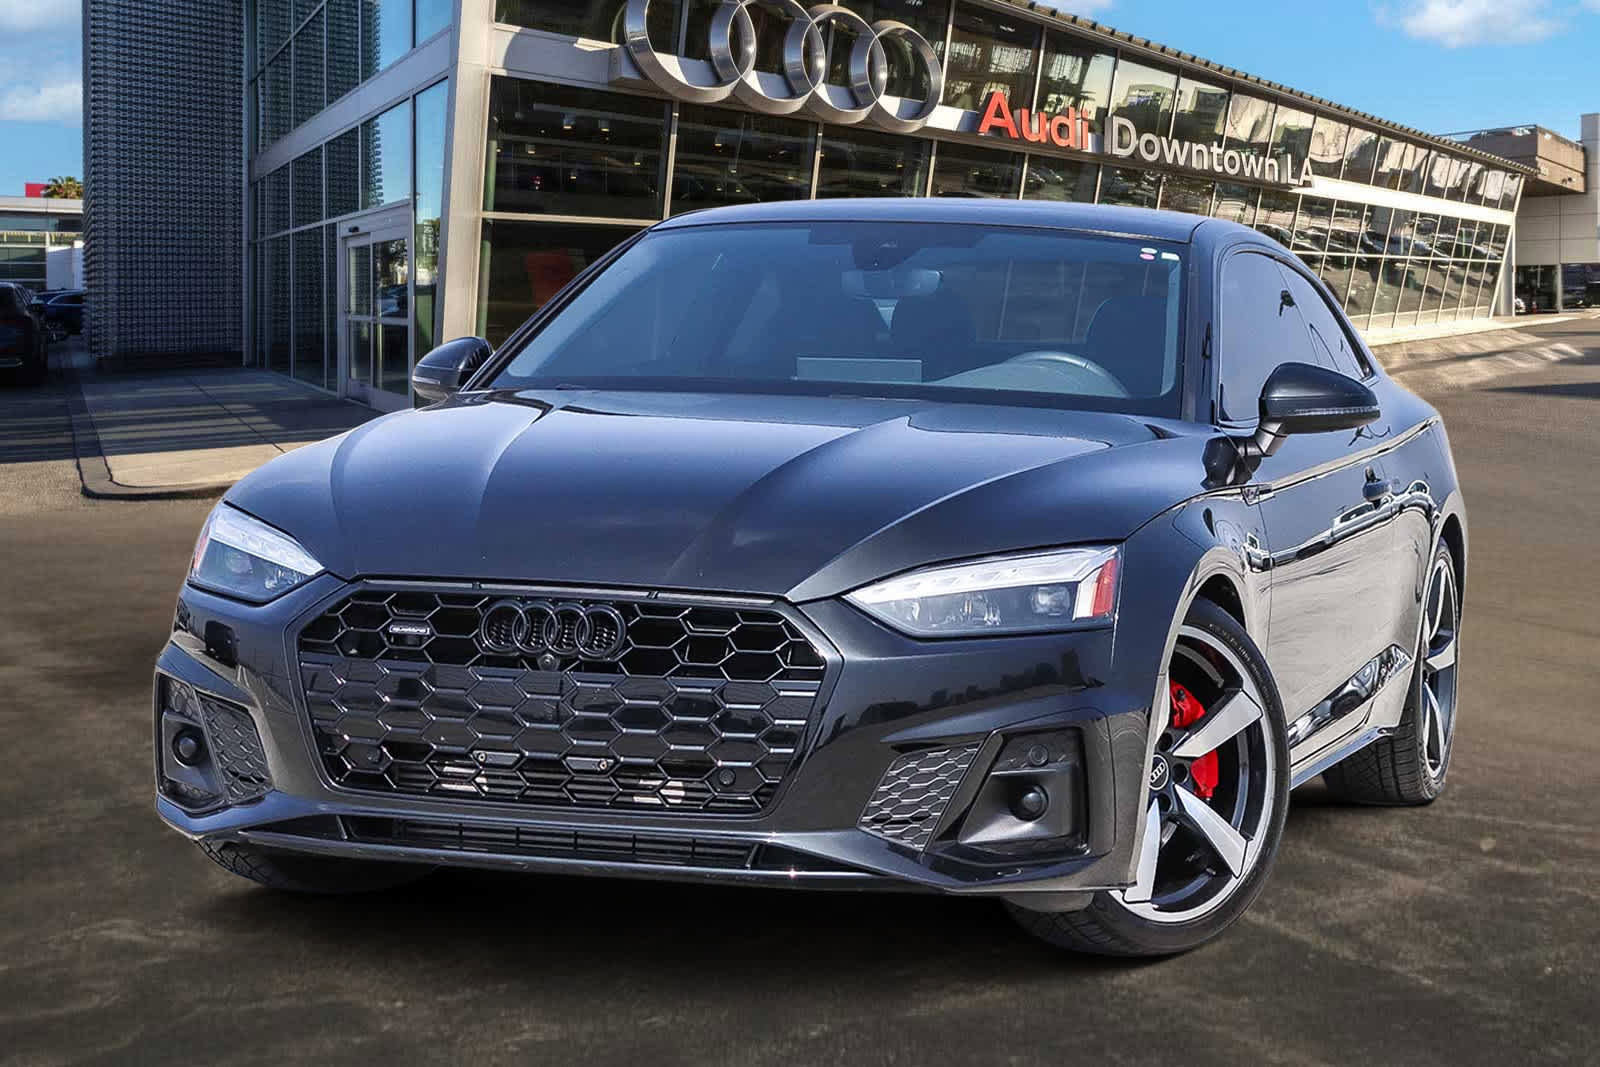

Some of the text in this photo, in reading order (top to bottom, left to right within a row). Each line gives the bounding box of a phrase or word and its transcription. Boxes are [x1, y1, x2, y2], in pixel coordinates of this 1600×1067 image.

[977, 91, 1315, 187] Audi Downtown LA
